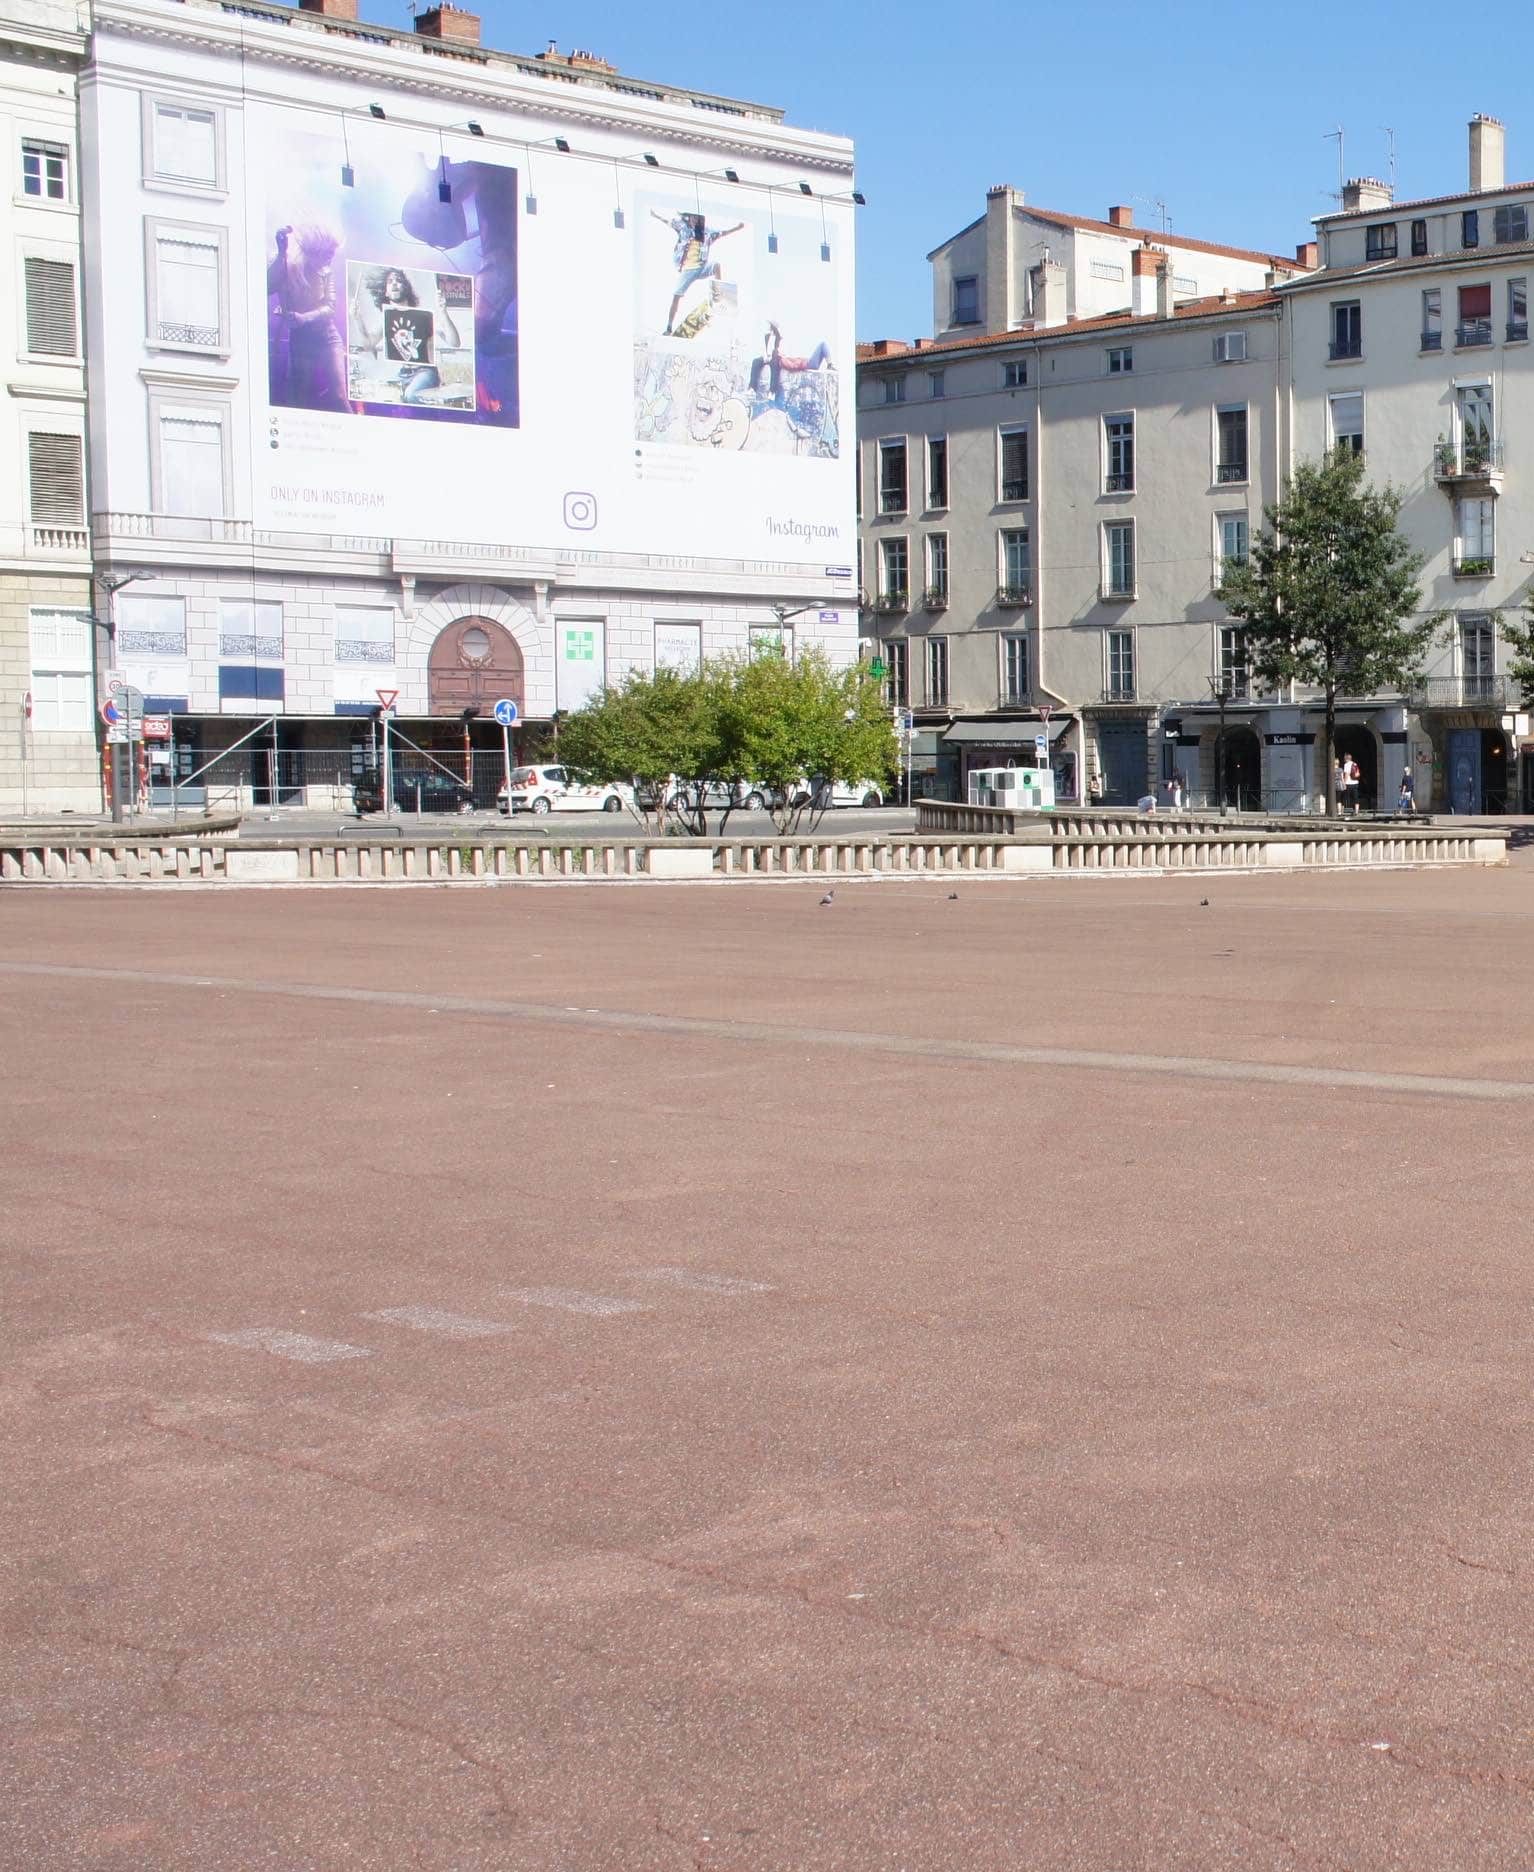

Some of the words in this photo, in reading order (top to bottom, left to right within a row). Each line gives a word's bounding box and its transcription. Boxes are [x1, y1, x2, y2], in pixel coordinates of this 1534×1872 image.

[271, 486, 299, 502] ONLY
[303, 488, 318, 503] ON
[321, 488, 385, 507] INSTAGRAM
[766, 516, 840, 545] Instagram
